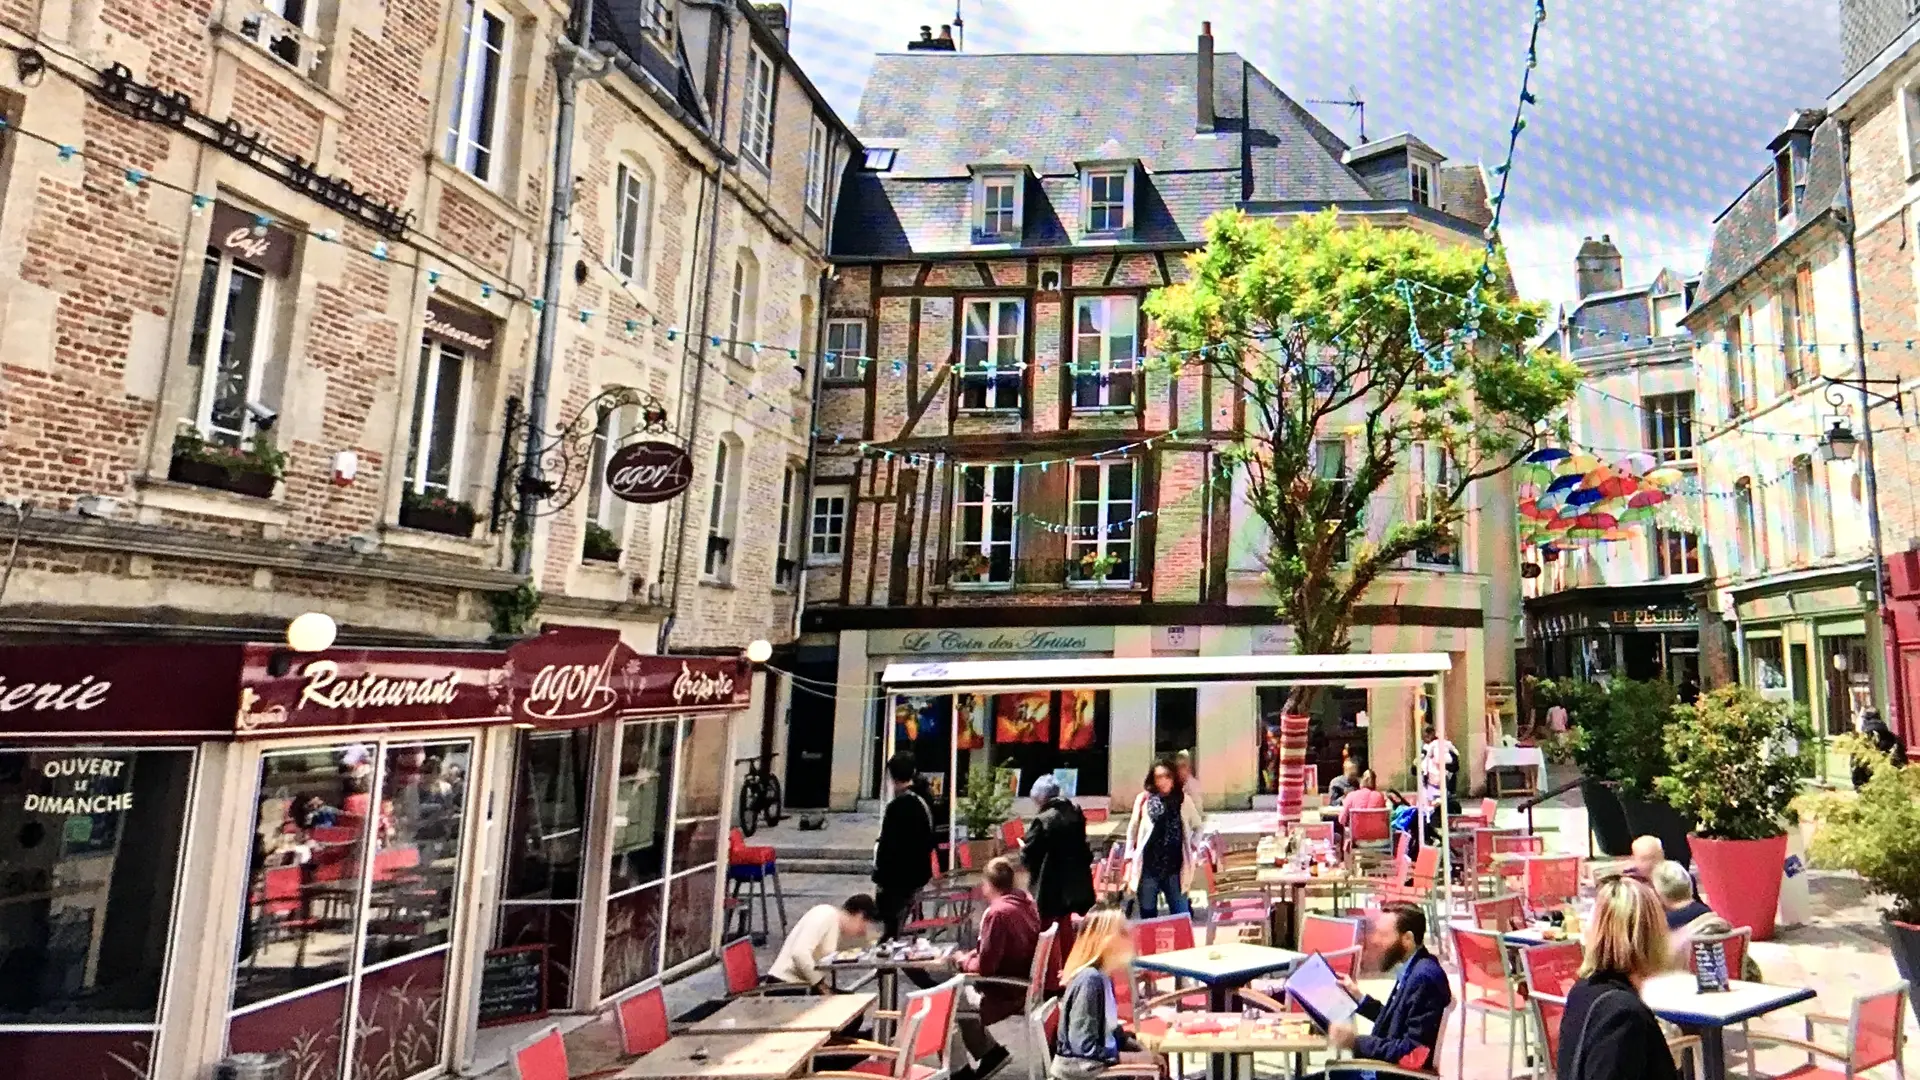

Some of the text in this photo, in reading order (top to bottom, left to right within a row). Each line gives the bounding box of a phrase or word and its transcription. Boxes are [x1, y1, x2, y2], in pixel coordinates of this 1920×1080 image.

[902, 629, 1087, 651] Le Coin des Artistes
[298, 660, 462, 710] Restaurant
[43, 758, 125, 778] OUVERT
[74, 780, 90, 792] LE
[24, 792, 134, 814] DIMANCHE
